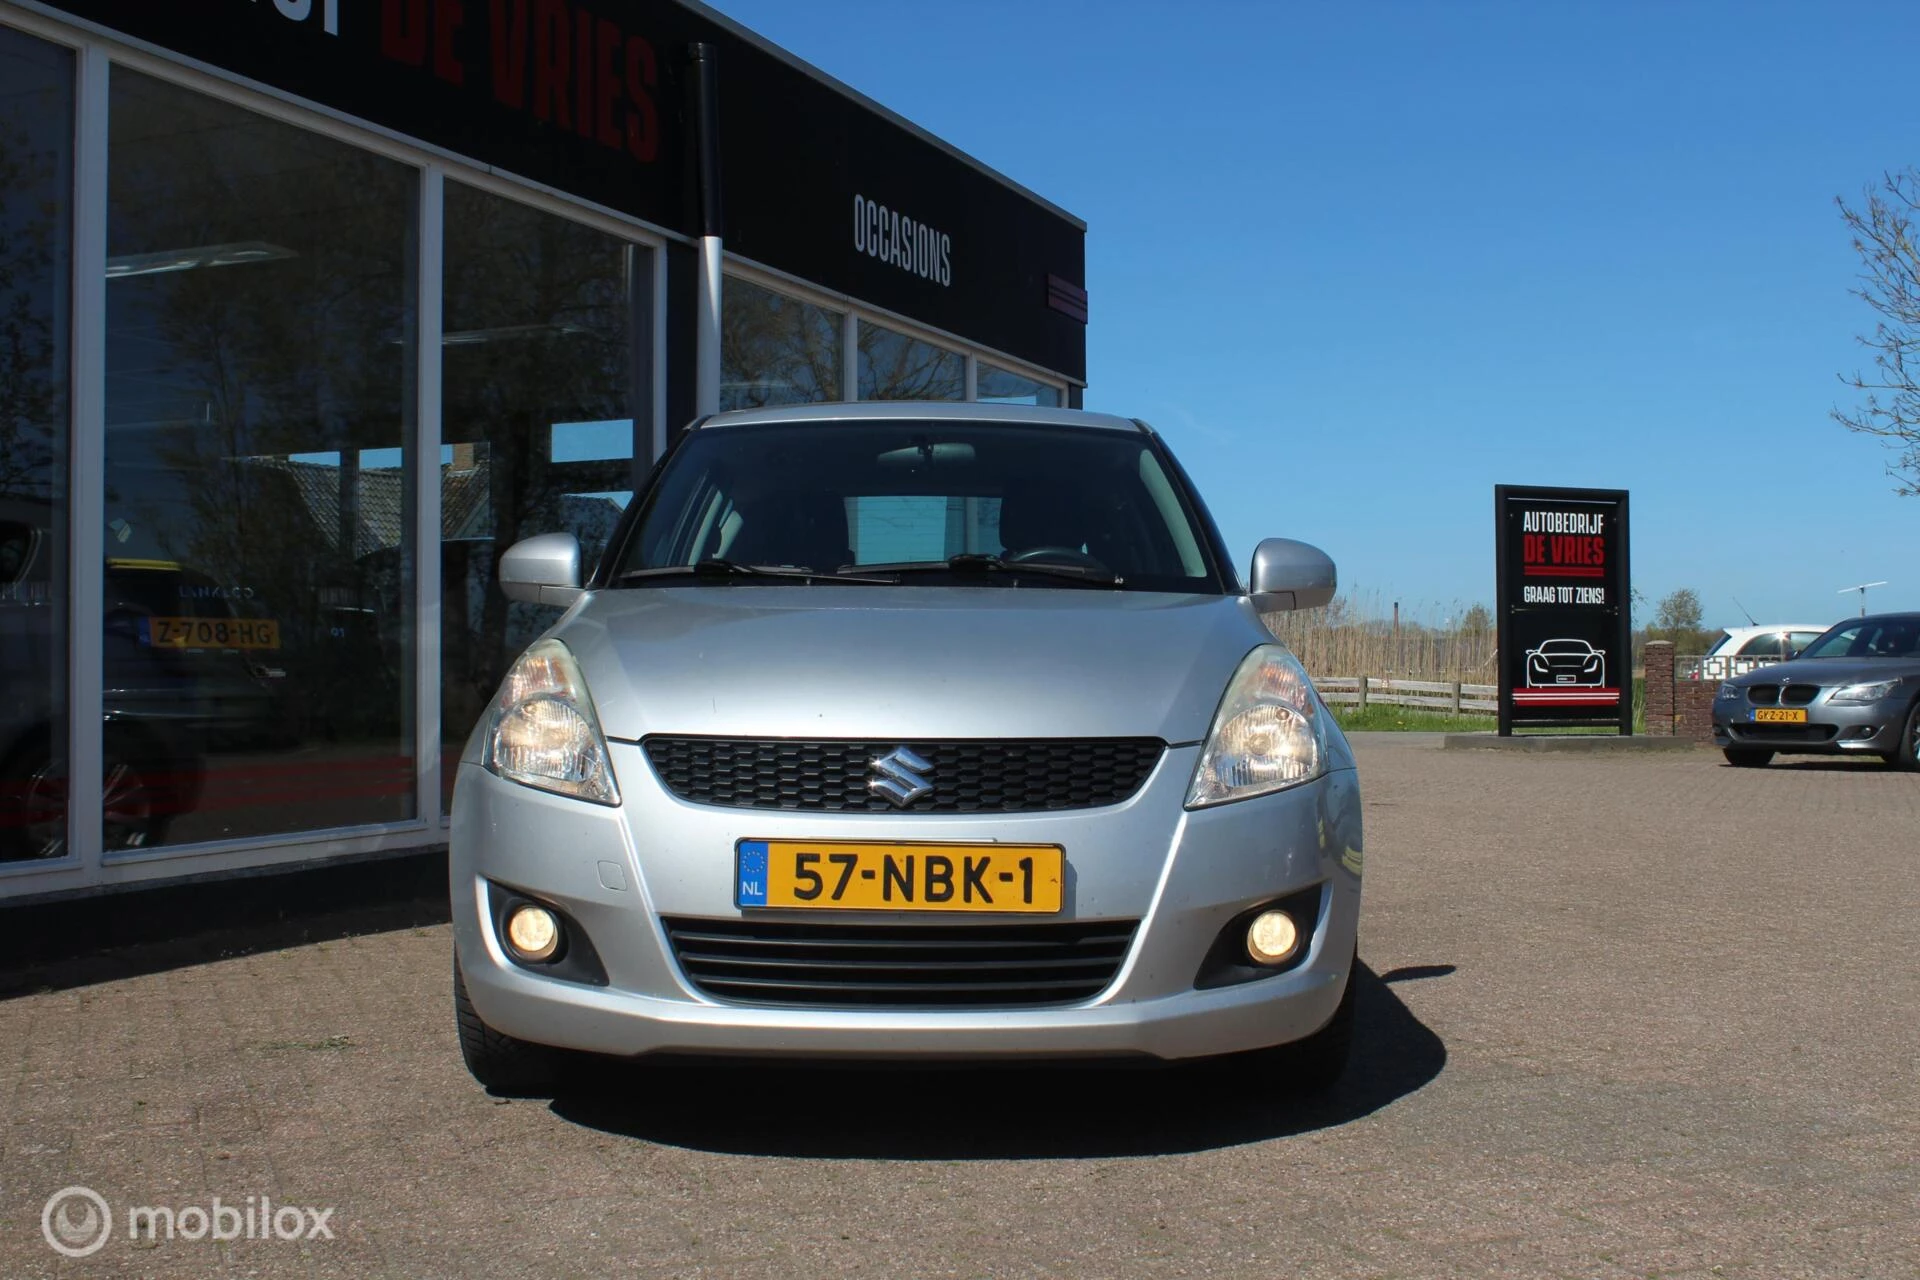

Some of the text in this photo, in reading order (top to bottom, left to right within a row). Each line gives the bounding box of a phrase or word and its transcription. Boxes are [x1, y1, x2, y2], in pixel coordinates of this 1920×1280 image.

[482, 0, 660, 164] VRIES
[854, 194, 951, 287] OCCASIONS
[1523, 511, 1604, 534] AUTOBEDRIJF
[1523, 534, 1605, 565] DE VRIES
[1523, 586, 1605, 604] GRAAG TOT ZIENS!
[157, 621, 272, 644] Z-708-HG
[742, 880, 763, 896] NL
[793, 853, 1034, 904] 57-NBK-1
